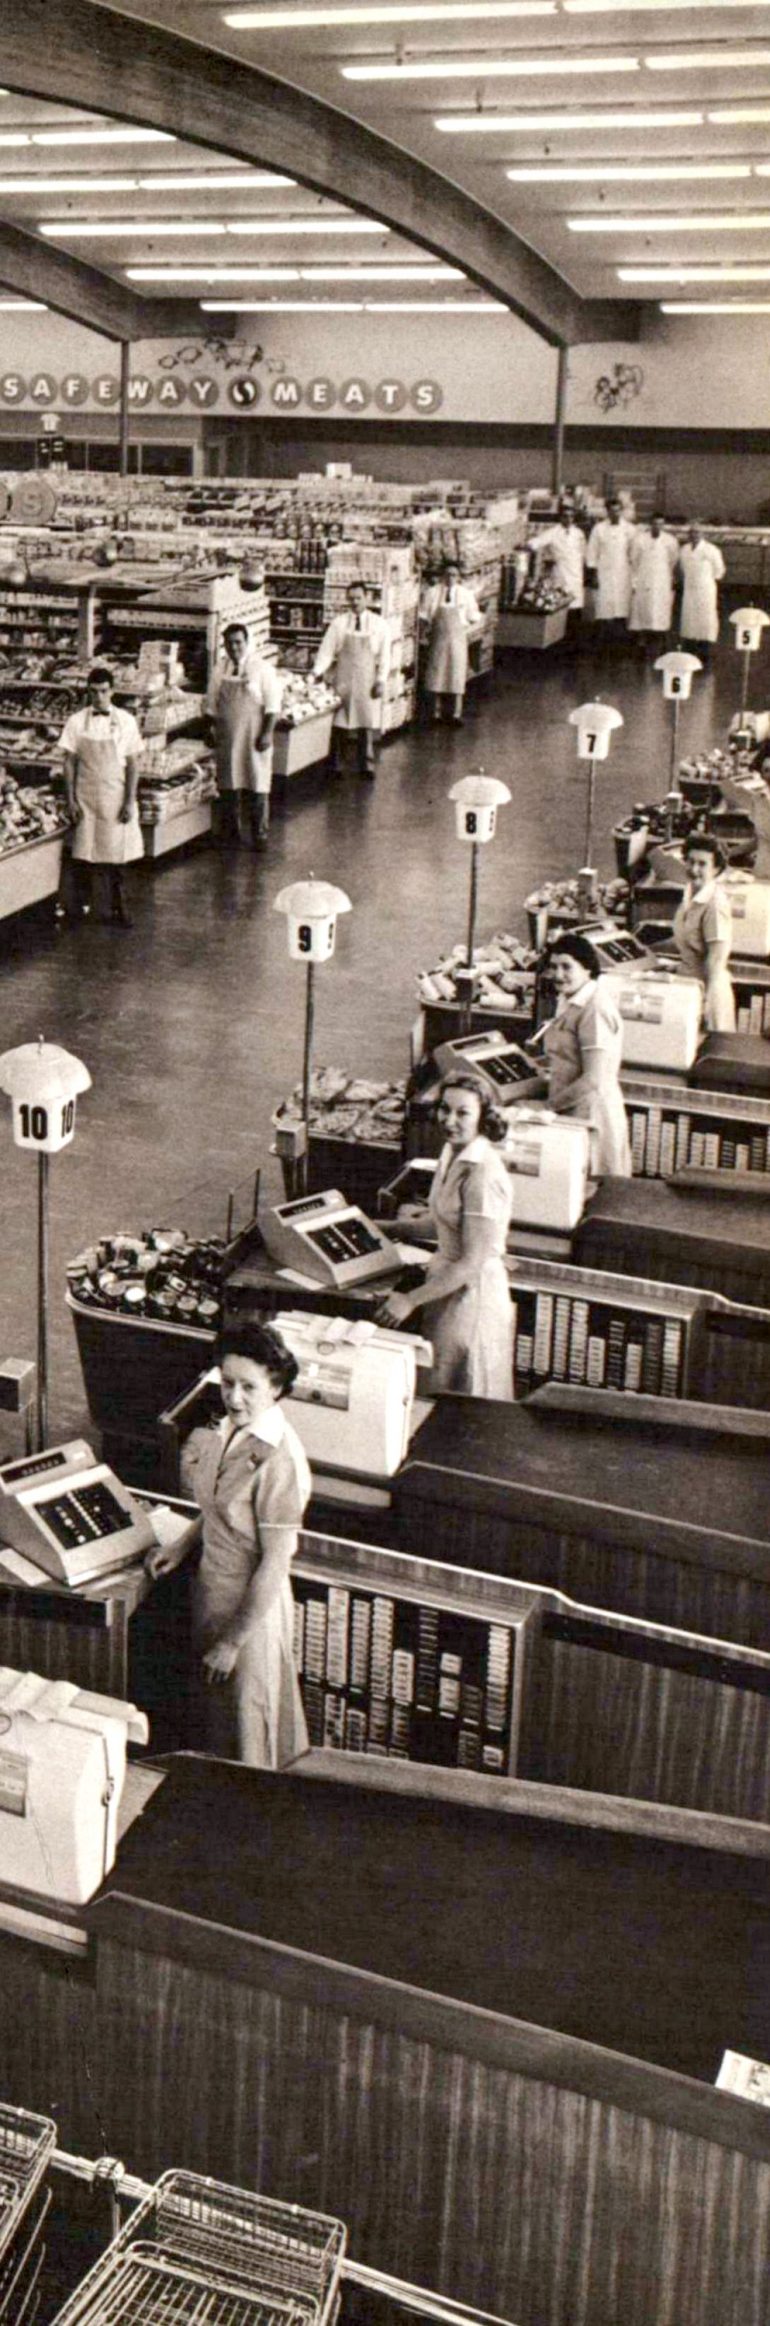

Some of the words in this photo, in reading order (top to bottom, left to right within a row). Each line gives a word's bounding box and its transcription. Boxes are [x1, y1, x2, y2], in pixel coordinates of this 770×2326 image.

[4, 378, 211, 400] SAFEWAY
[273, 382, 434, 406] MEATS
[742, 630, 750, 645] 5
[671, 676, 680, 693] 6
[586, 734, 597, 753] 7
[465, 811, 477, 834] 8
[298, 925, 312, 952] 9
[19, 1103, 48, 1140] 10
[61, 1100, 74, 1138] 10
